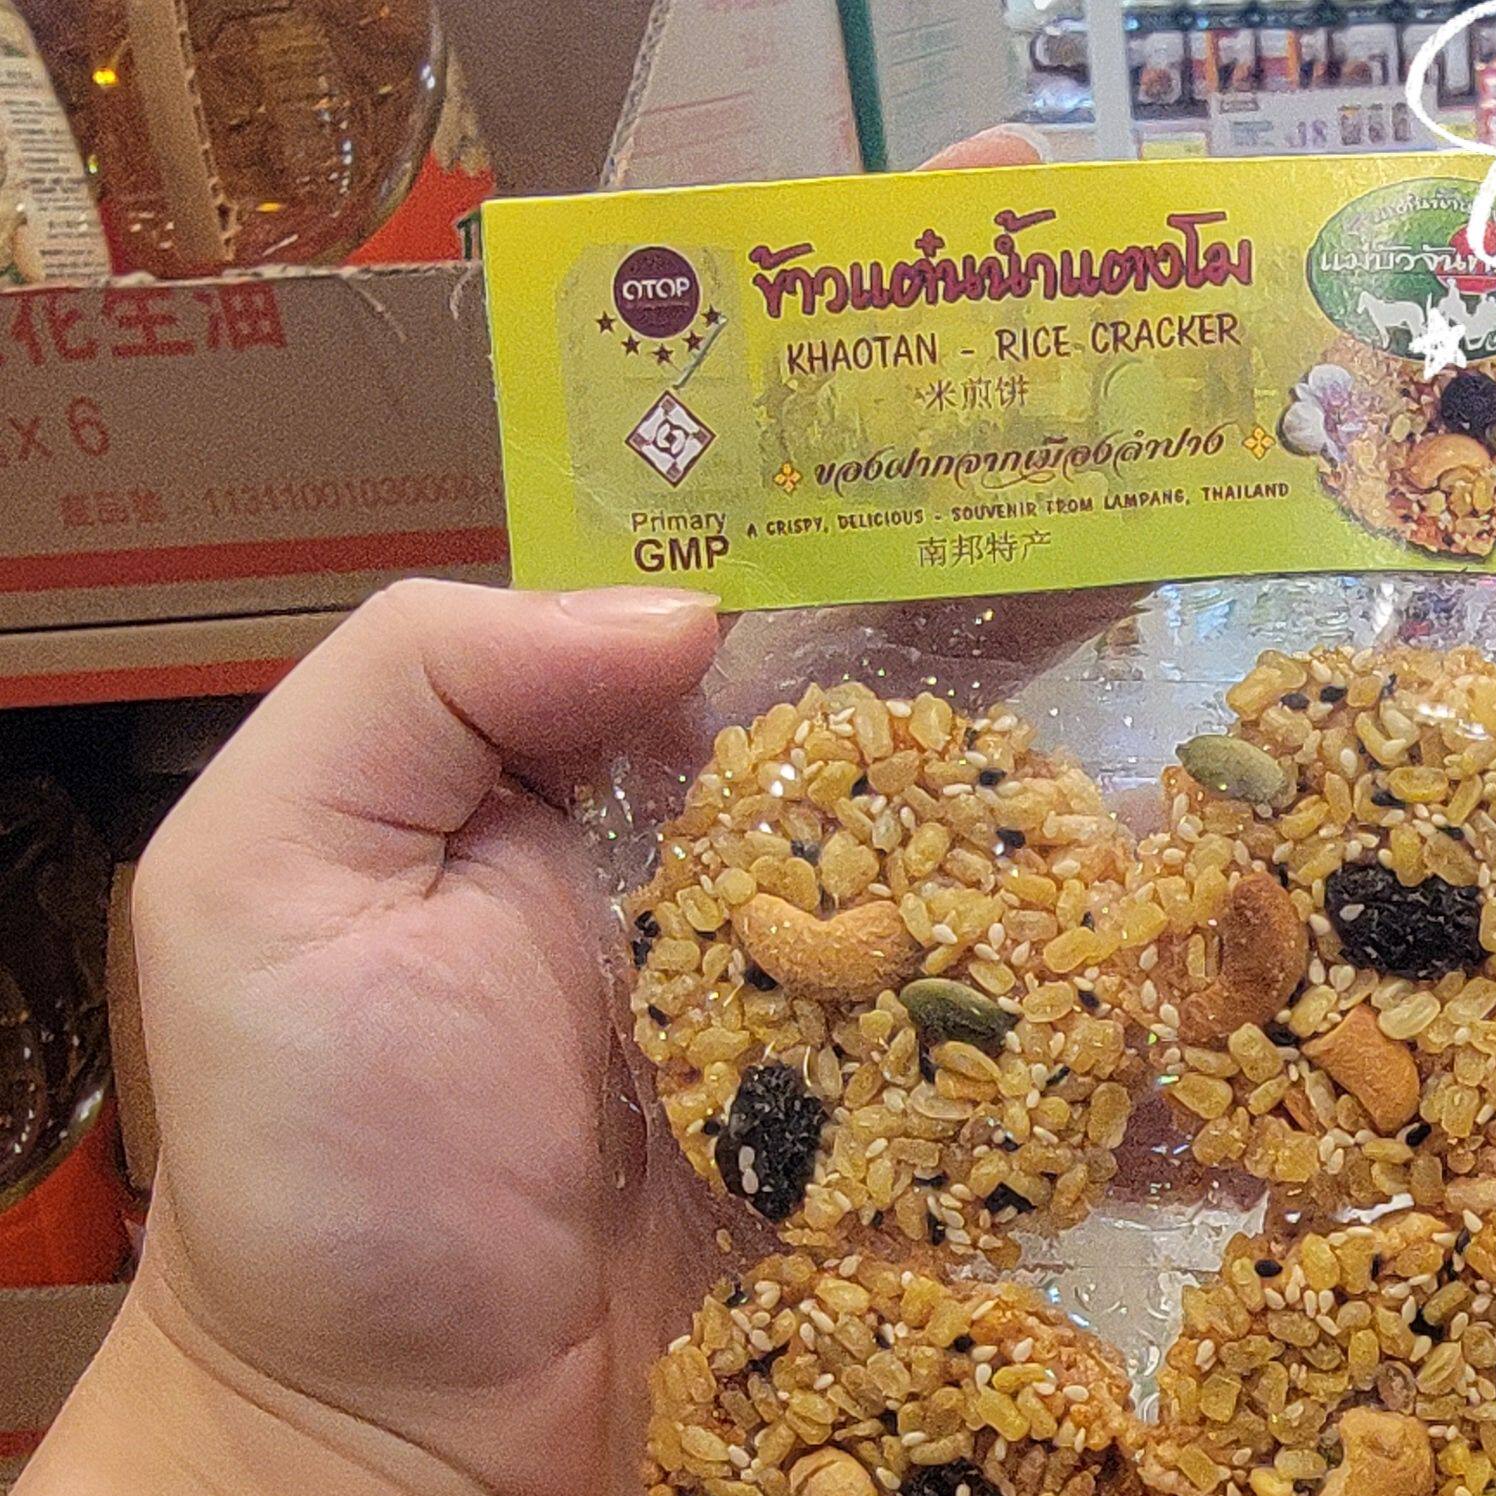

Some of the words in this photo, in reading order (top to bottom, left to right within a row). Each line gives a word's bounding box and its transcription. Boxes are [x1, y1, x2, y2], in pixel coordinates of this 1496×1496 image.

[622, 278, 691, 301] OTOP
[787, 333, 938, 375] KHAOTAN
[996, 326, 1072, 362] RICE
[1091, 313, 1241, 354] CRACKER
[925, 376, 1030, 412] 米煎饼
[631, 512, 726, 534] Primary
[747, 523, 758, 538] A
[766, 517, 829, 536] CRISPY,
[838, 509, 925, 530] DELICIOUS
[951, 501, 1037, 522] SOUVENIR
[1048, 497, 1093, 516] FROM
[1104, 488, 1191, 510] LAMPANG,
[1202, 482, 1290, 502] THAILAND
[634, 535, 730, 573] GMP
[917, 527, 1052, 568] 南邦特产
